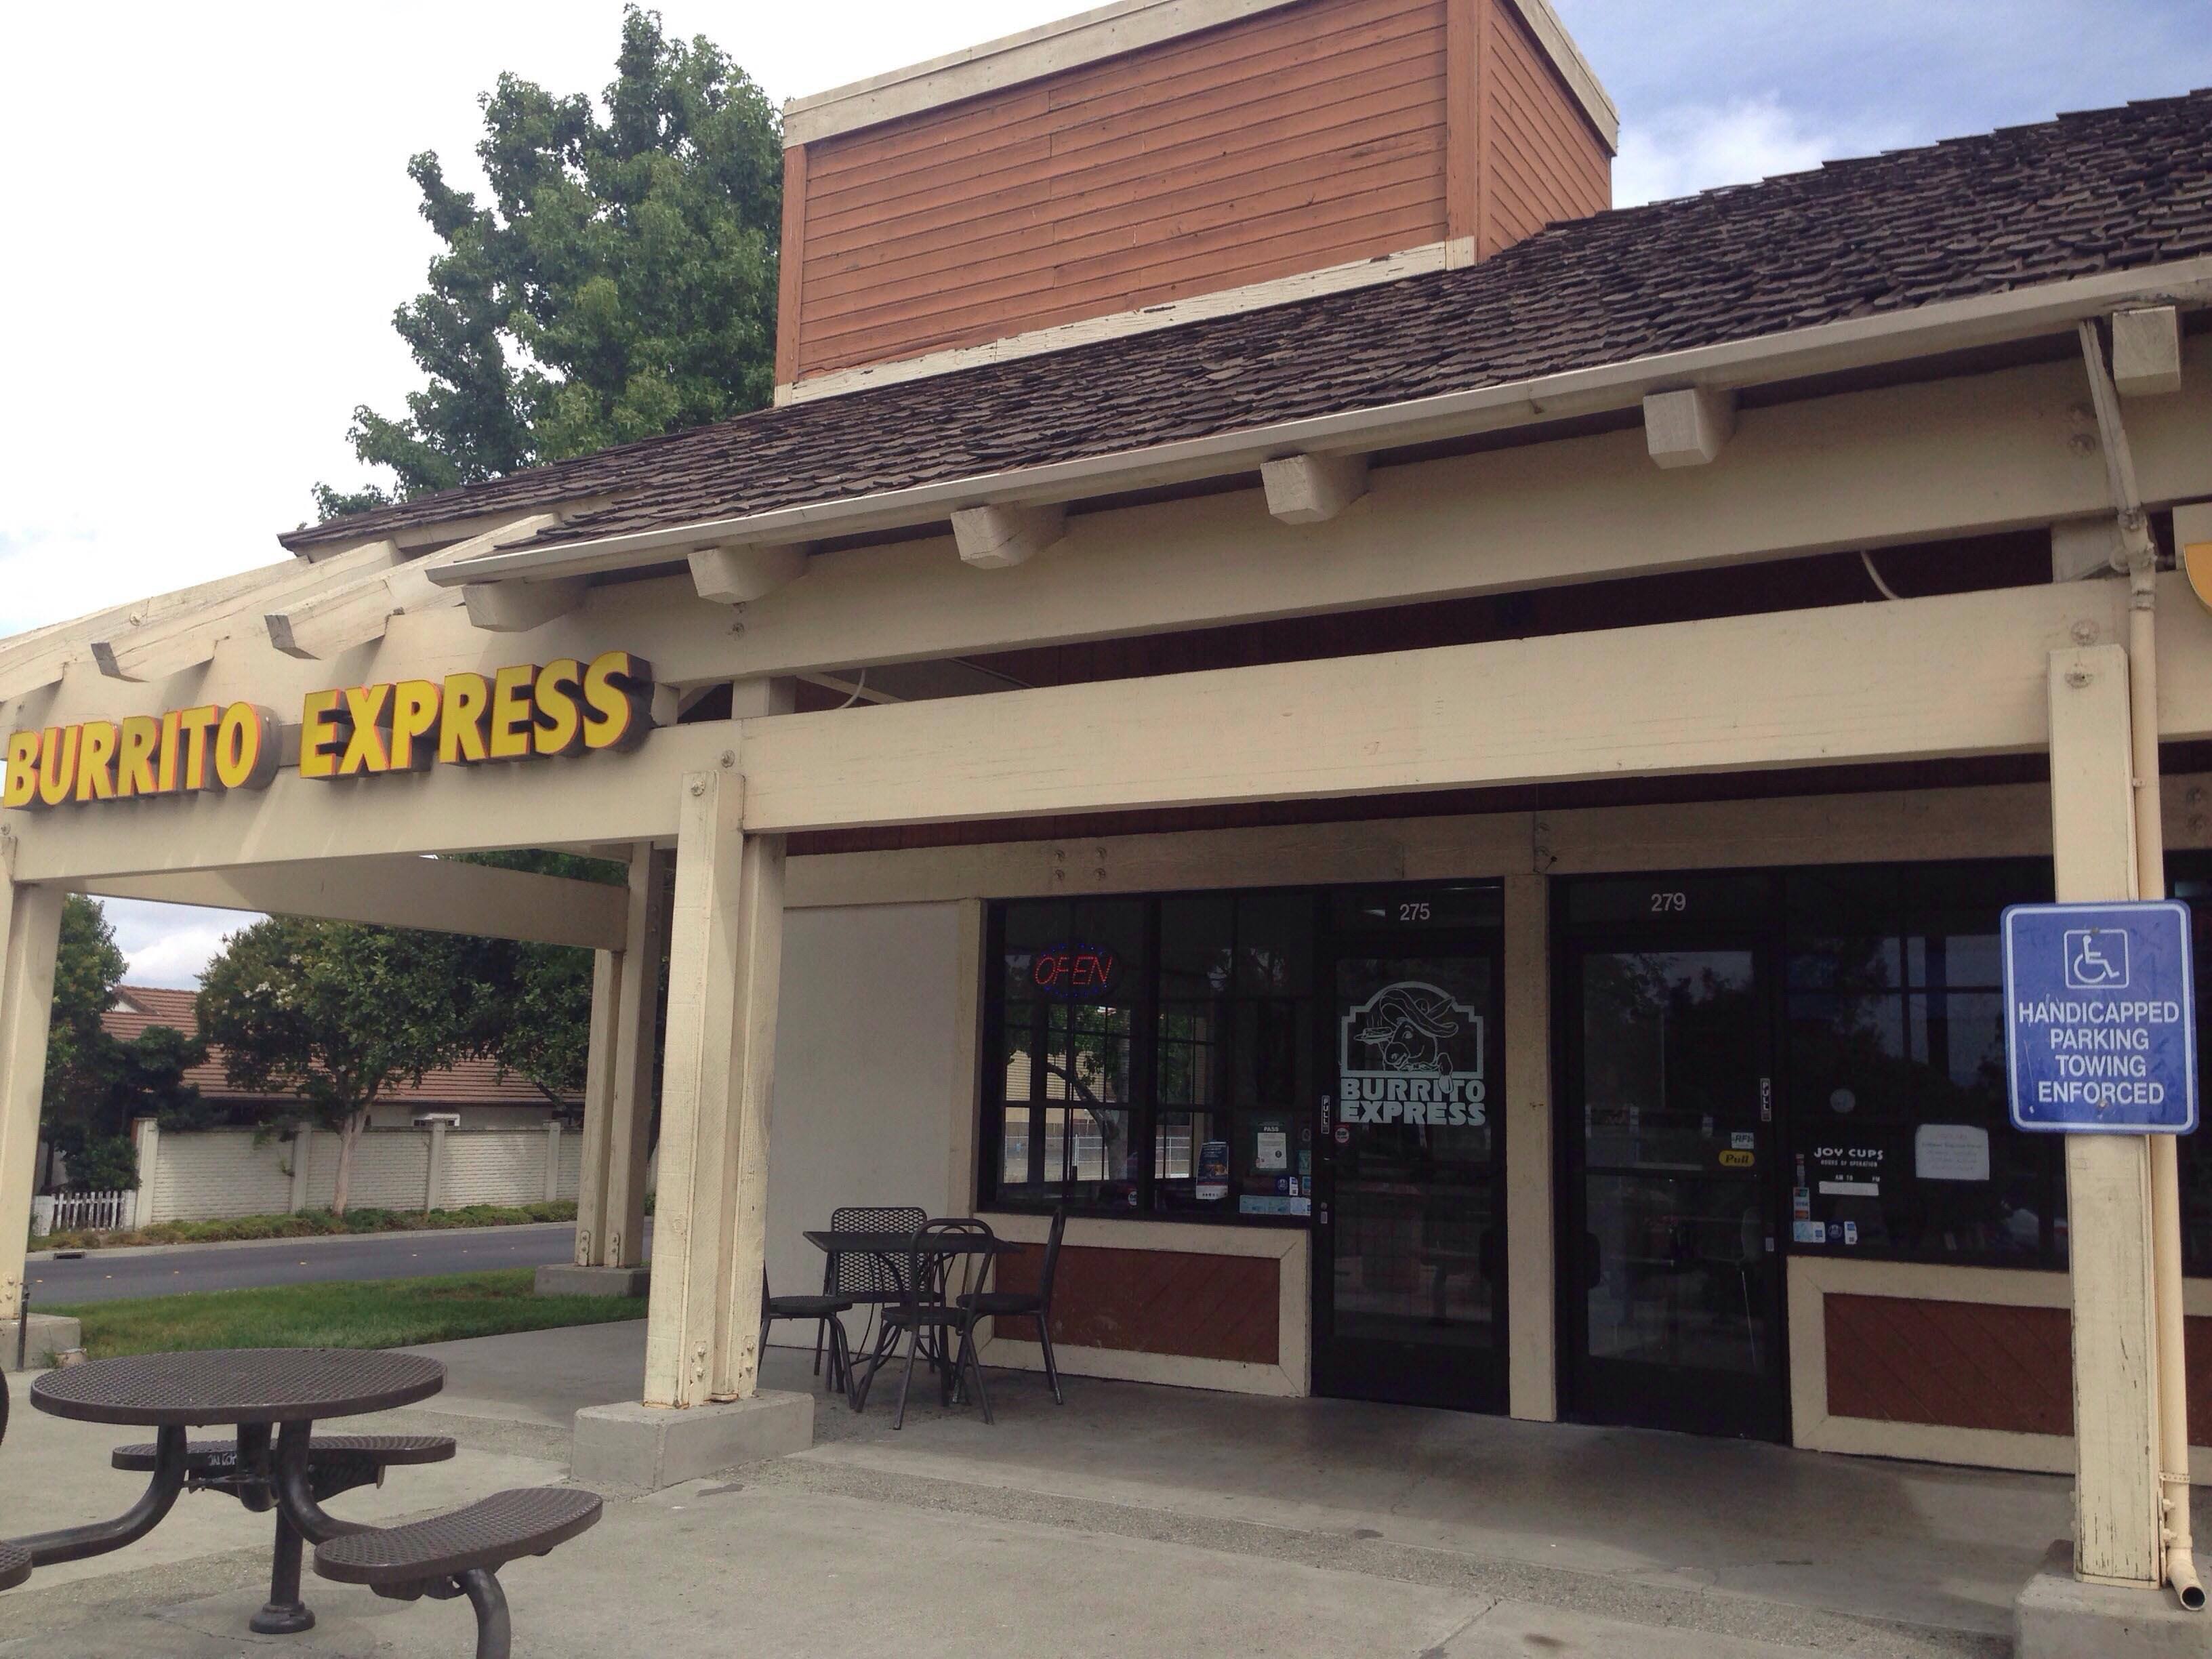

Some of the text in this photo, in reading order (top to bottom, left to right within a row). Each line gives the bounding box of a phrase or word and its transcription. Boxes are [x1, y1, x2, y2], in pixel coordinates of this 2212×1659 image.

[3, 651, 634, 810] BURRITO EXPRESS
[1399, 903, 1430, 920] 275
[1651, 892, 1686, 912] 279
[2018, 1001, 2180, 1024] HANDICAPPED
[2049, 1027, 2150, 1050] PARKING
[2054, 1054, 2147, 1078] TOWING
[1340, 1078, 1486, 1103] BURRITO
[1762, 1082, 1770, 1111] PULL
[2037, 1080, 2165, 1105] ENFORCED
[1340, 1100, 1486, 1126] EXPRESS
[1725, 1153, 1749, 1164] Pull
[1814, 1147, 1883, 1161] JOY CUPS
